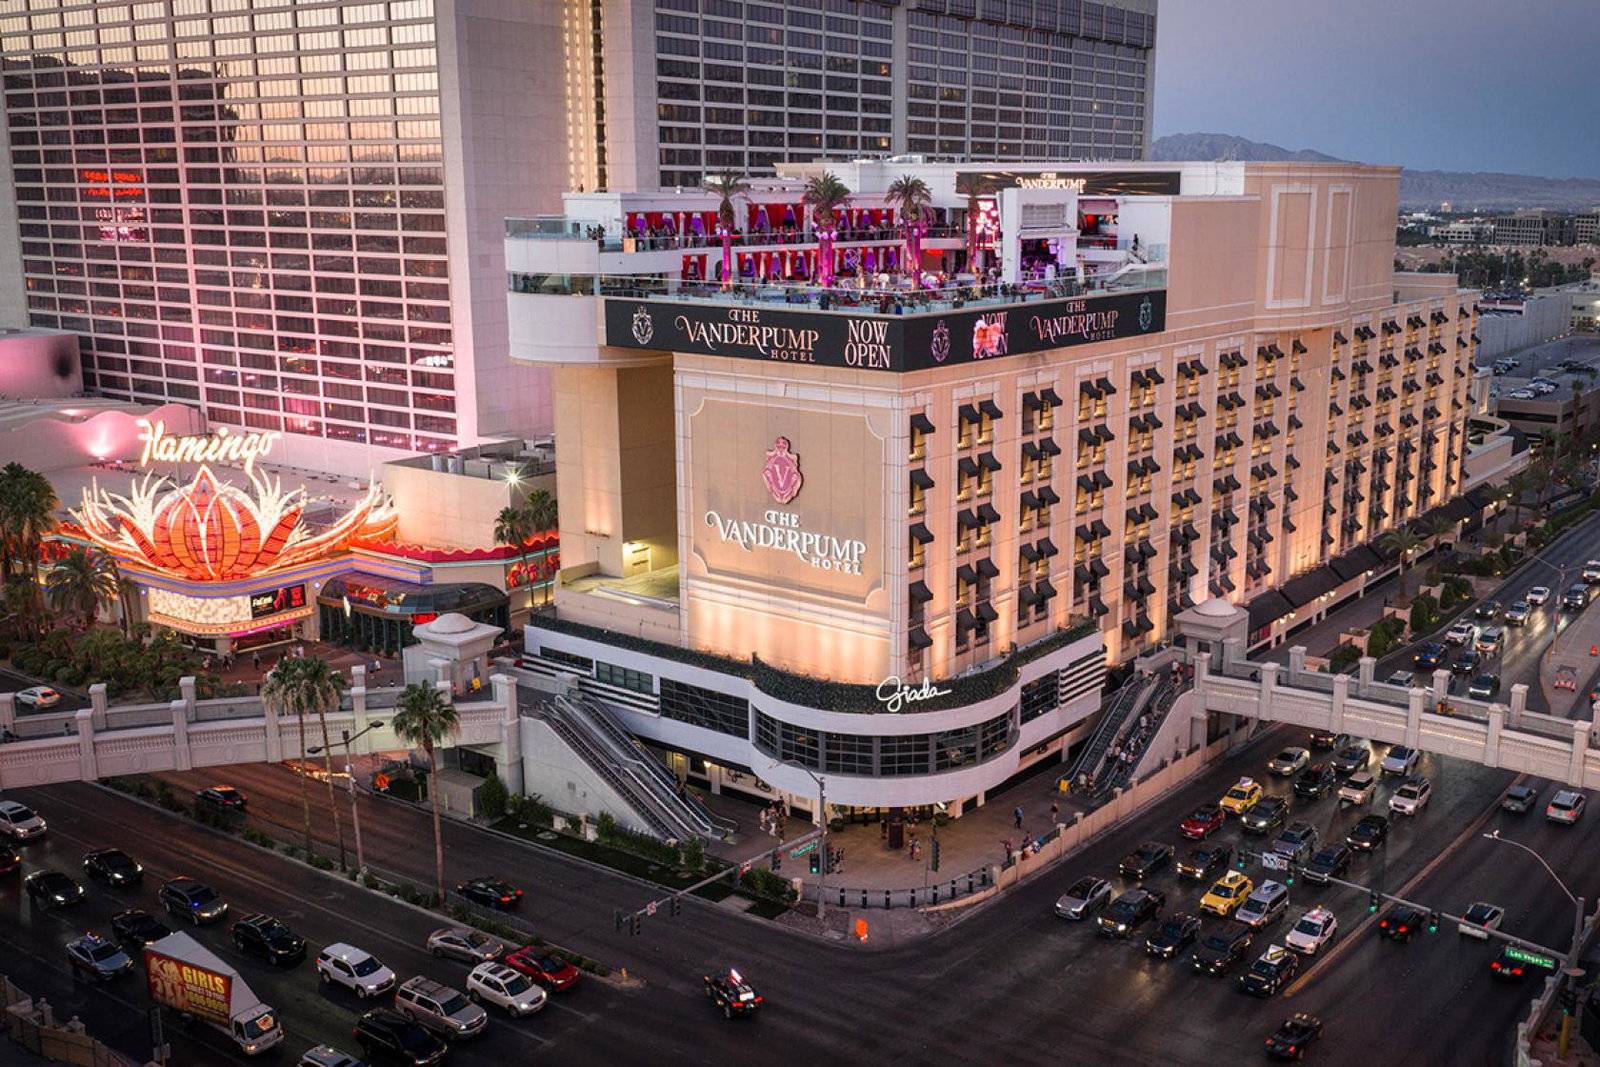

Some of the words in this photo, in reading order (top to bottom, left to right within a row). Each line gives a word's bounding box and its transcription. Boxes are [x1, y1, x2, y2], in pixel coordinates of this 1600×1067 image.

[1015, 176, 1087, 190] VANDERPUMP
[728, 308, 760, 323] THE
[1066, 300, 1087, 313] THE
[674, 315, 819, 355] VANDERPUMP
[847, 319, 889, 345] NOW
[1029, 310, 1118, 344] VANDERPUMP
[1089, 329, 1117, 340] HOTEL
[771, 350, 815, 362] HOTEL
[844, 342, 891, 368] OPEN
[136, 418, 282, 474] Flamingo
[765, 510, 800, 528] THE
[704, 510, 867, 563] VANDERPUMP
[811, 557, 863, 576] HOTEL
[876, 675, 953, 713] Giada
[1510, 950, 1522, 958] Las
[1523, 953, 1543, 965] Vegas
[181, 966, 225, 994] GIRLS
